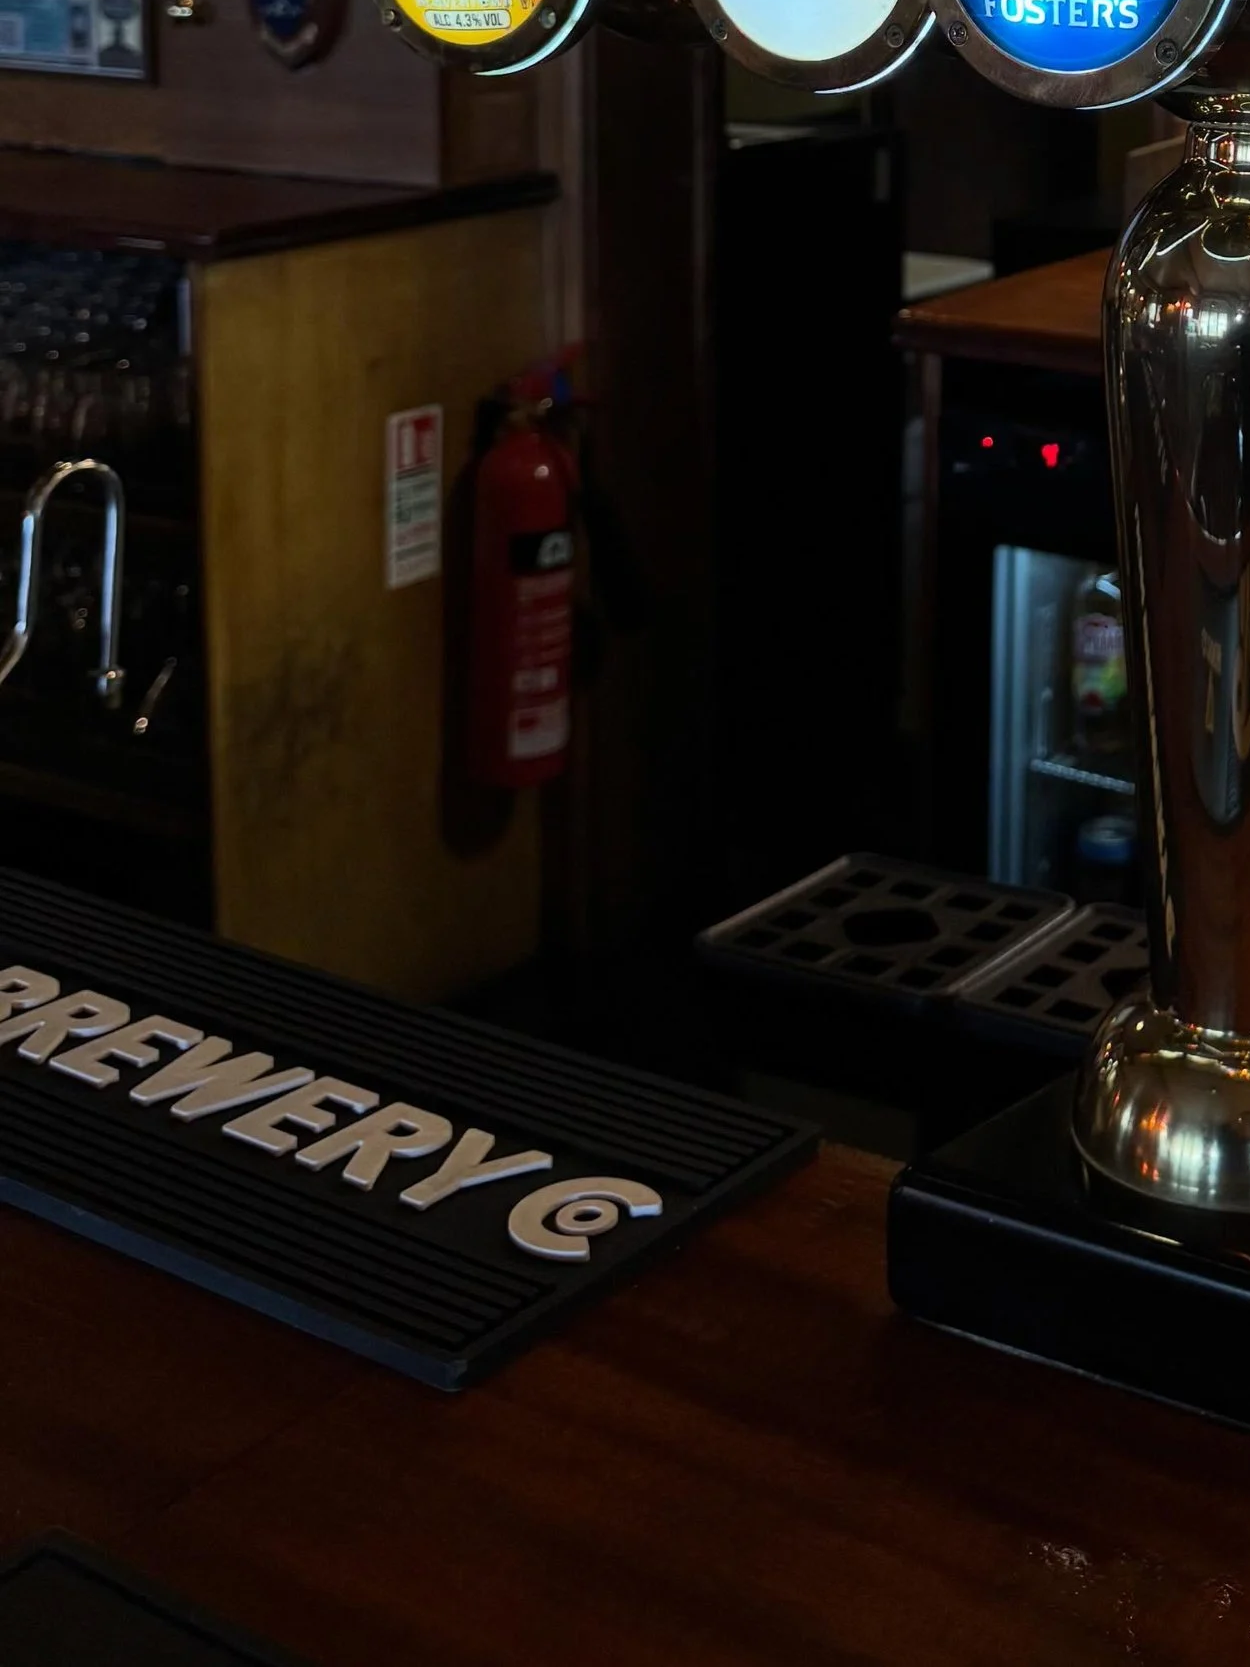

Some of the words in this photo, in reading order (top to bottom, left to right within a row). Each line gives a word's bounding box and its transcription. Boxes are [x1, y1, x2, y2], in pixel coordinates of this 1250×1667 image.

[433, 13, 451, 27] ALC
[455, 13, 481, 28] 4.3%
[484, 13, 504, 27] VOL
